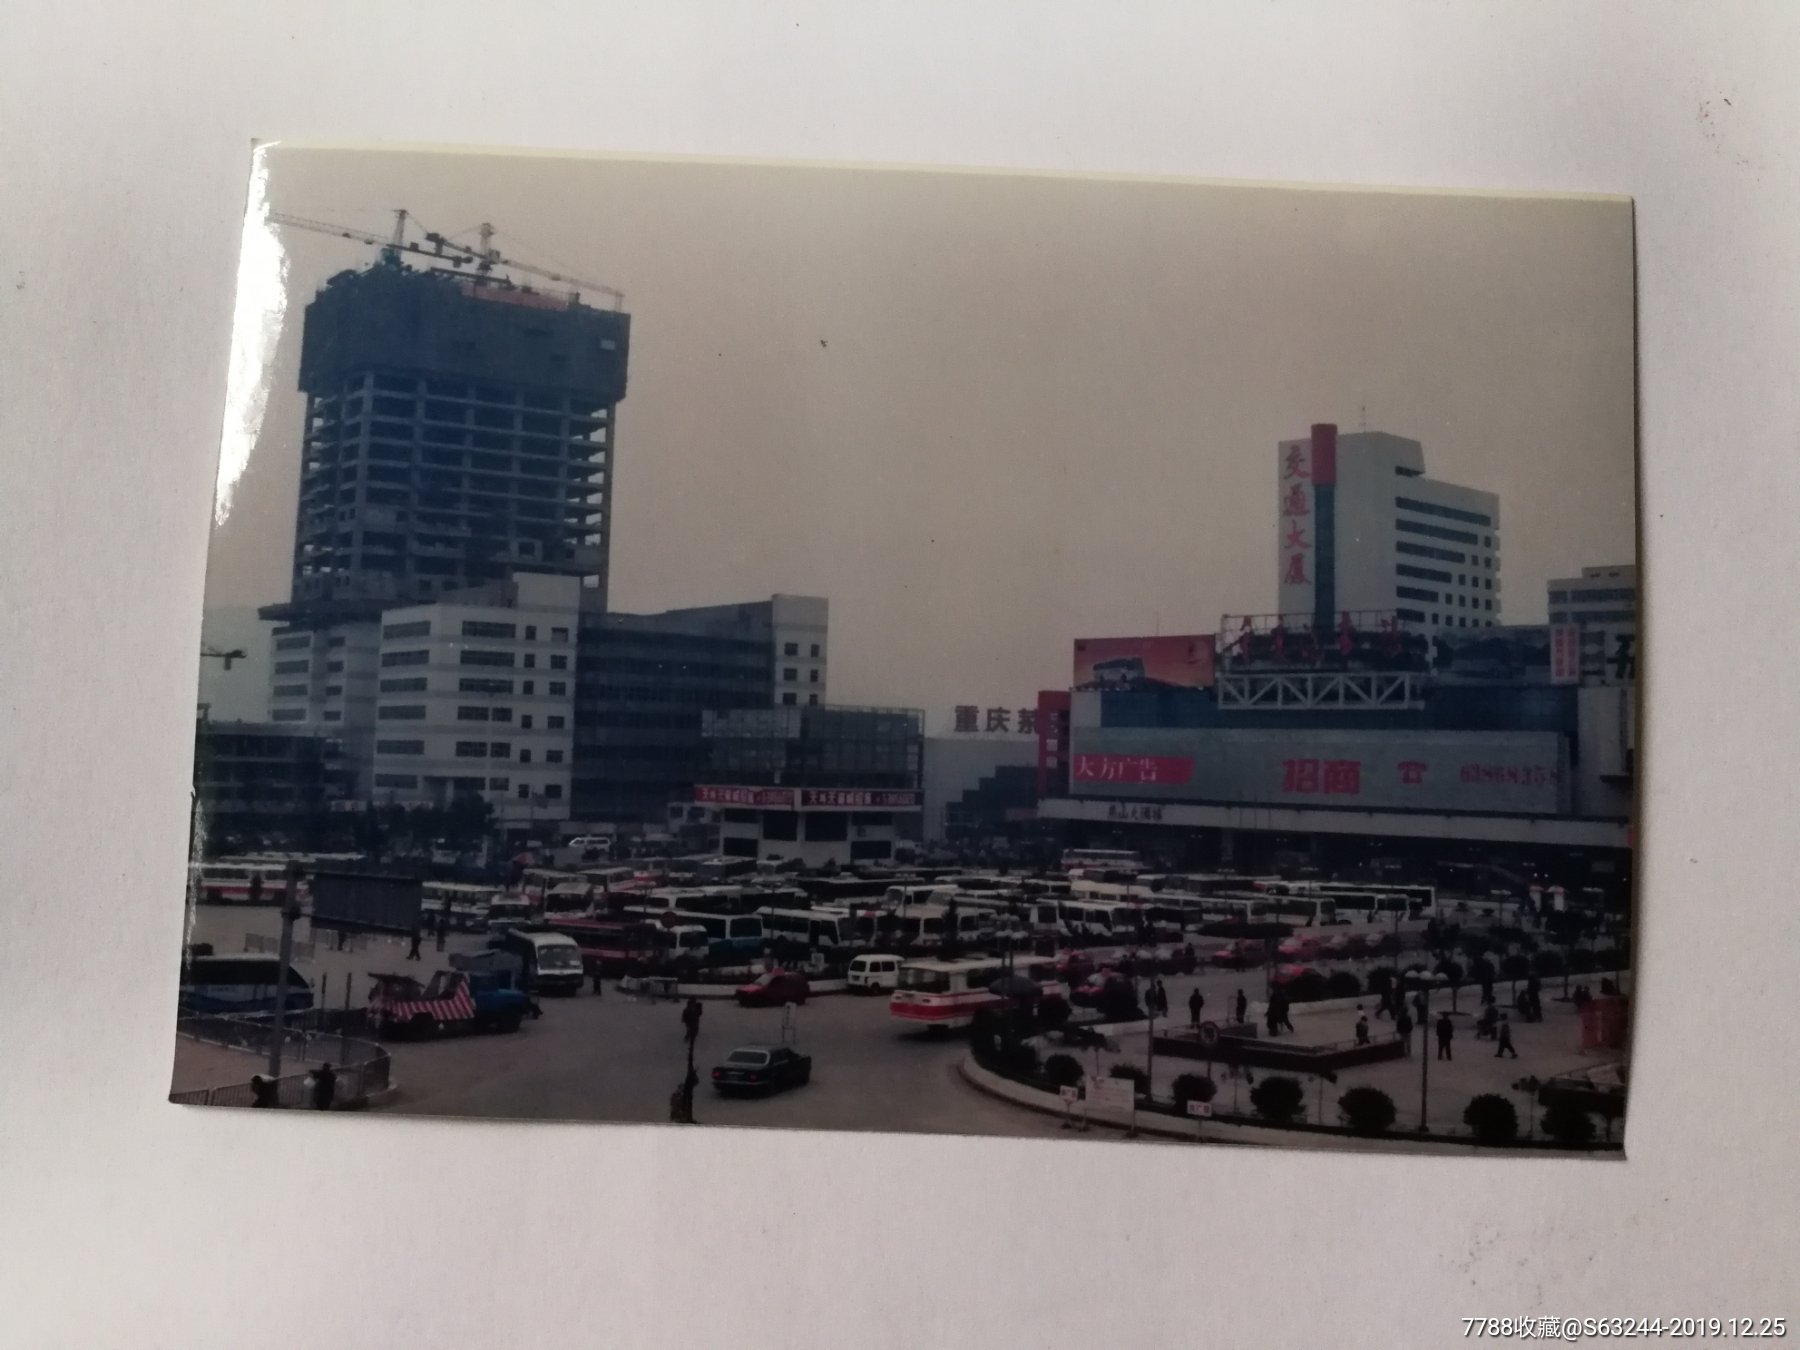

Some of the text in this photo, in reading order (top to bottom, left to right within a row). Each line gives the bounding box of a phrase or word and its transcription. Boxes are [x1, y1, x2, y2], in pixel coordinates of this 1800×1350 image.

[1079, 755, 1160, 785] 大方广告
[1282, 758, 1361, 794] 招商
